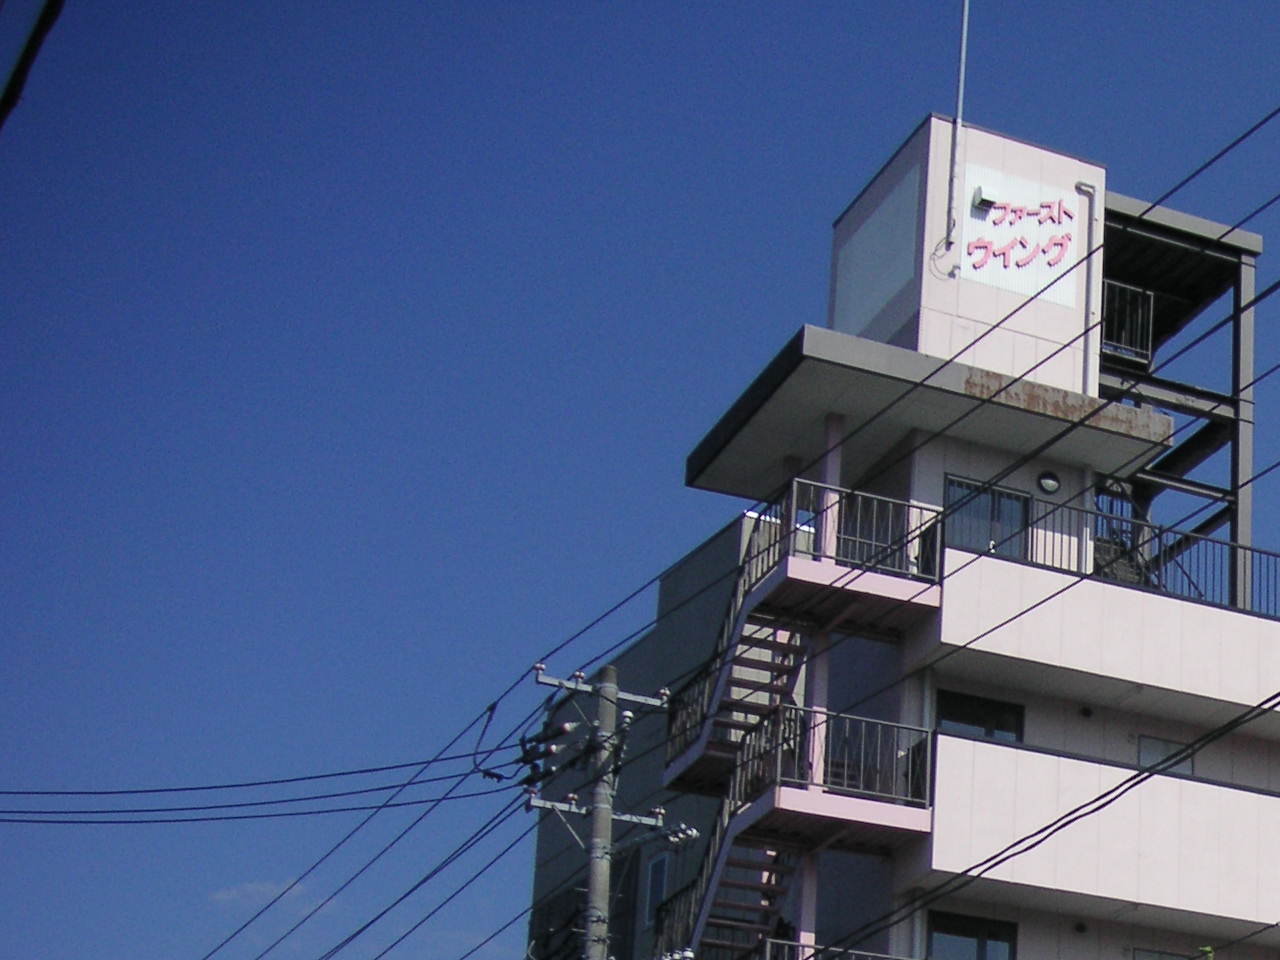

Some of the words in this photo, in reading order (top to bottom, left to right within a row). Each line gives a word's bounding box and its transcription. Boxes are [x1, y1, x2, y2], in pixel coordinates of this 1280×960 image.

[992, 199, 1074, 227] ファースト
